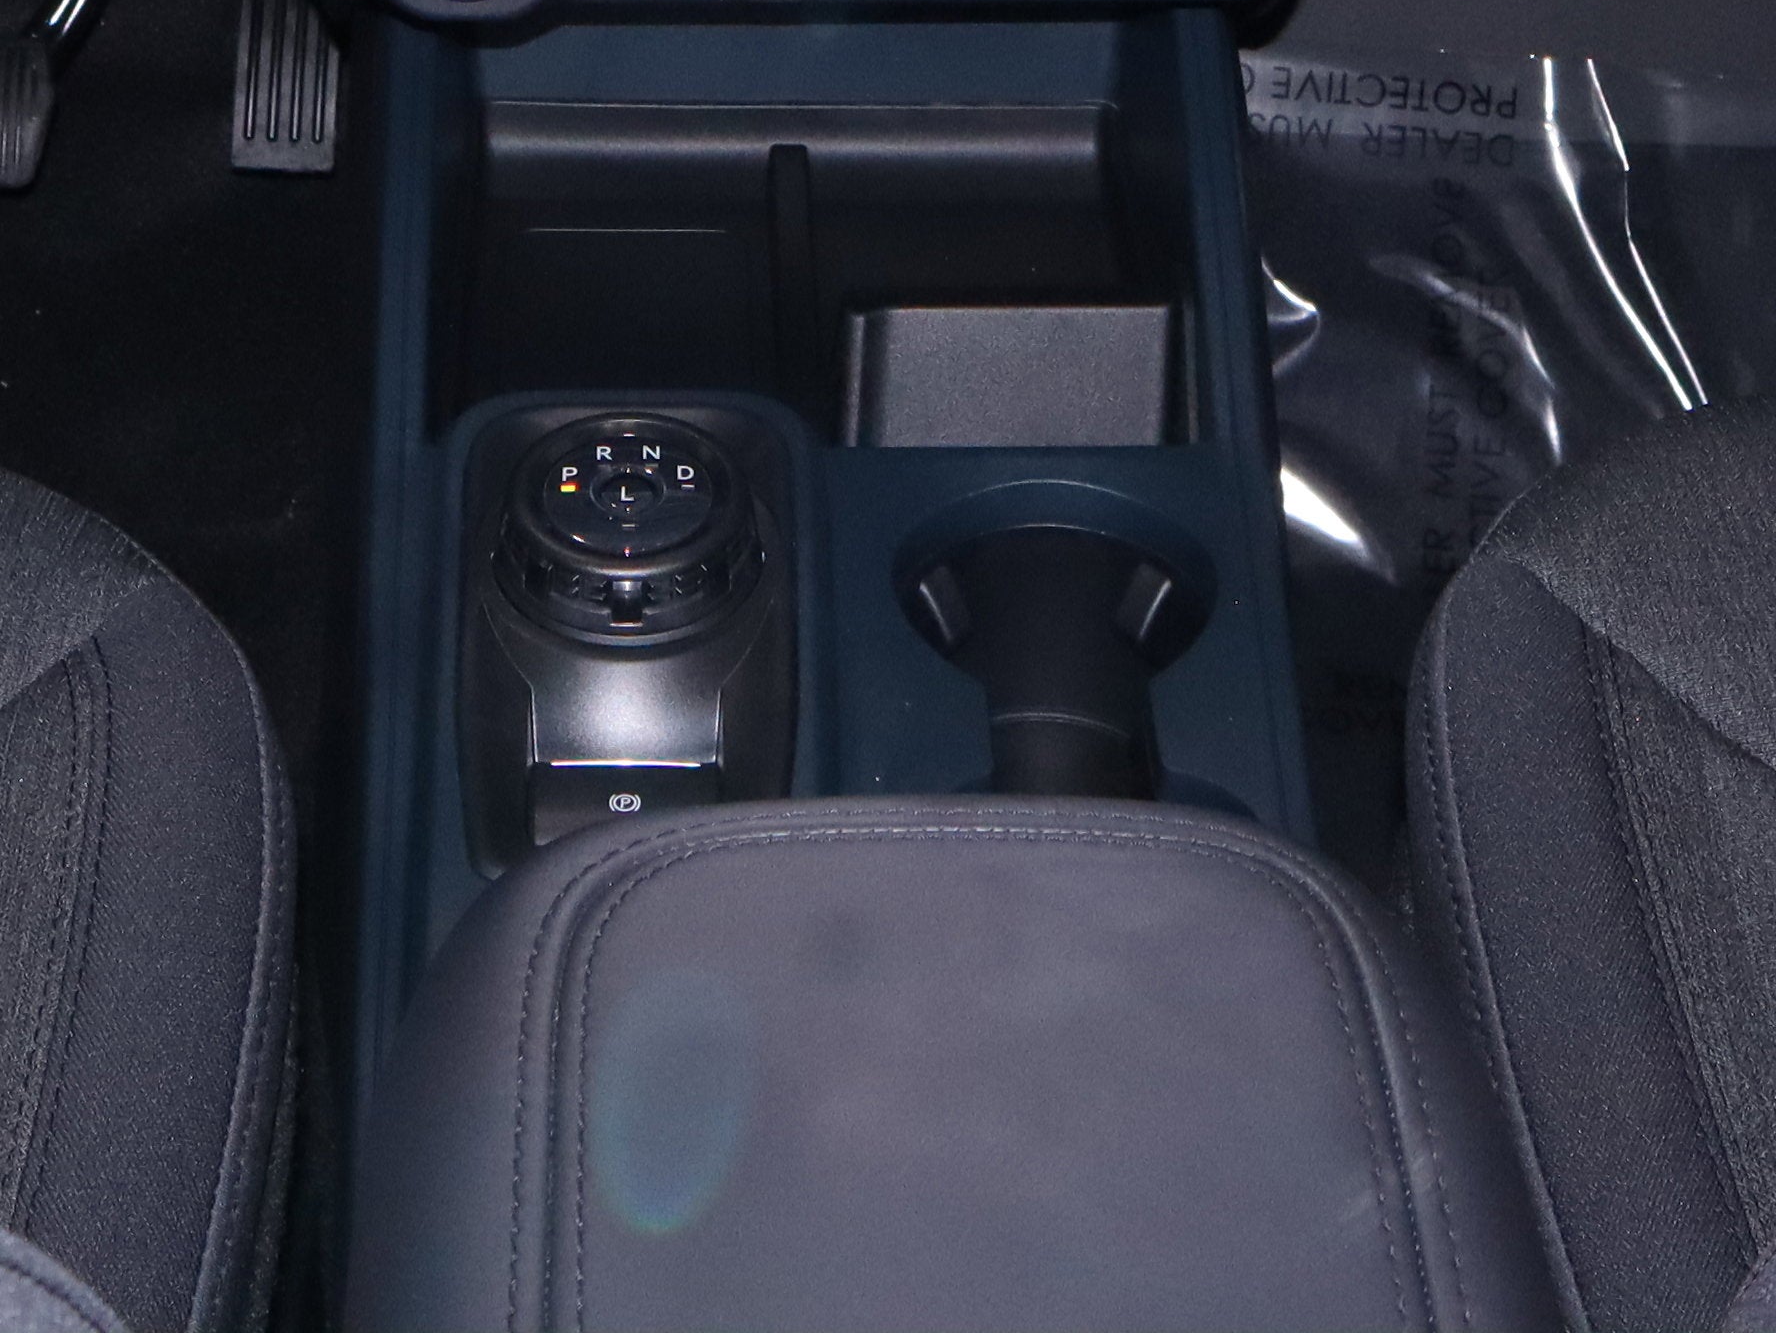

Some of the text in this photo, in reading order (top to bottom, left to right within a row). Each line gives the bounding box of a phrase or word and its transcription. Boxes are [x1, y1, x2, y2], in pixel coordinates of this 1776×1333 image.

[1270, 65, 1518, 120] PROTECTIVE
[1362, 121, 1515, 167] DEALER
[1425, 177, 1464, 358] REOVE
[562, 445, 695, 482] P R N D
[620, 486, 635, 502] L
